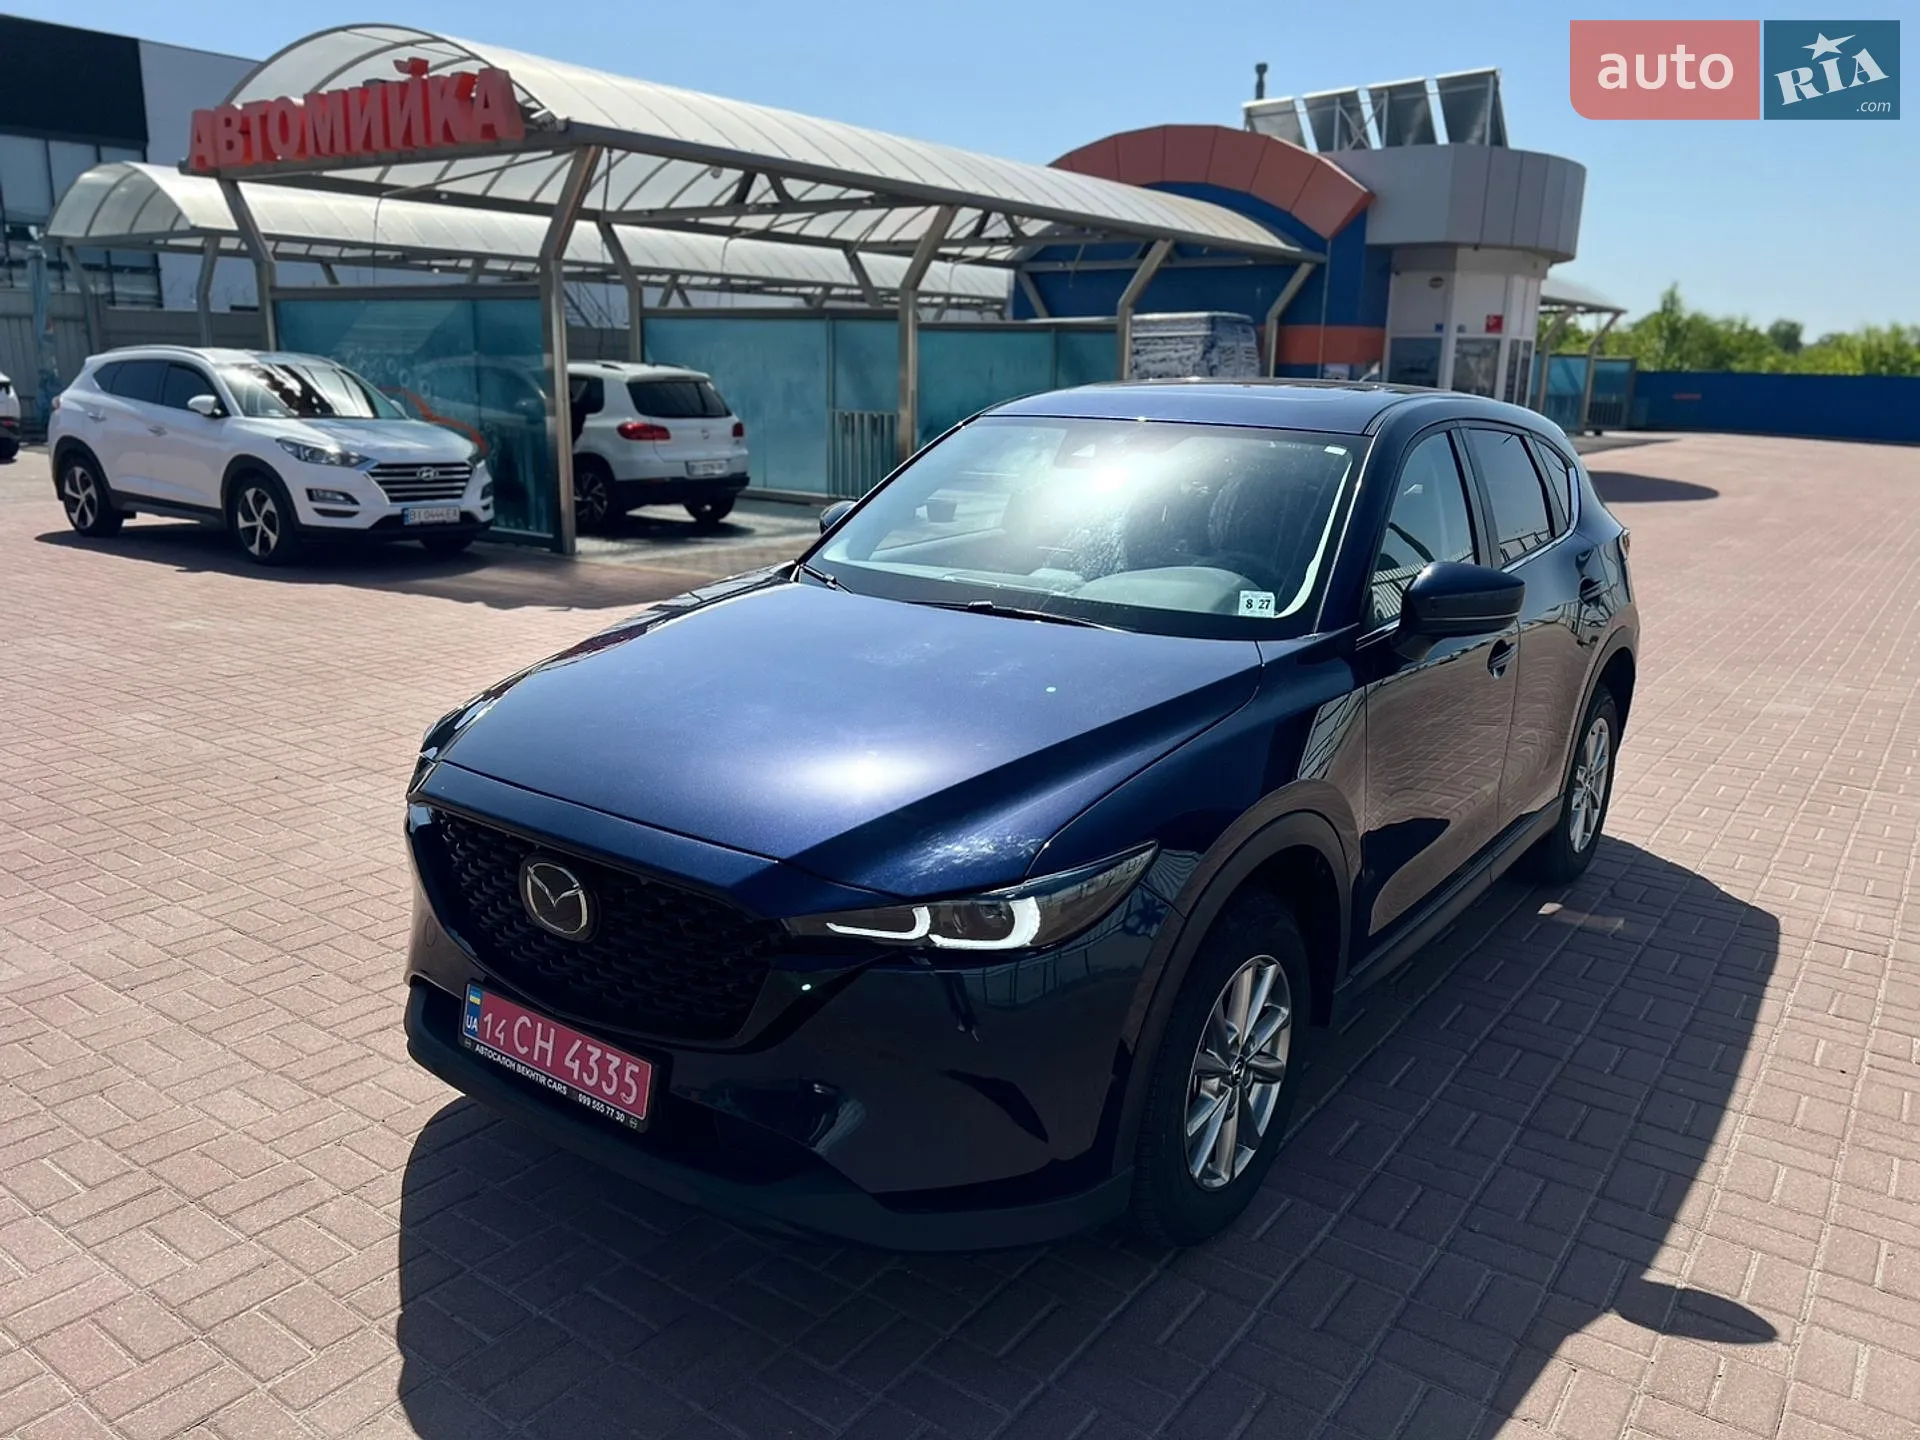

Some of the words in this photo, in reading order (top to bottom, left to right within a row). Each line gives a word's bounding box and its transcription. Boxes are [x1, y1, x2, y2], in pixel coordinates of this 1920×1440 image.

[188, 57, 525, 172] АВТОМИЙКА
[1246, 599, 1253, 609] 8
[1258, 599, 1271, 609] 27
[466, 1014, 479, 1032] UA
[483, 1013, 507, 1046] 14
[513, 1015, 555, 1068] CH
[564, 1040, 639, 1105] 4335
[547, 1077, 568, 1096] CARS
[605, 1105, 615, 1117] 77
